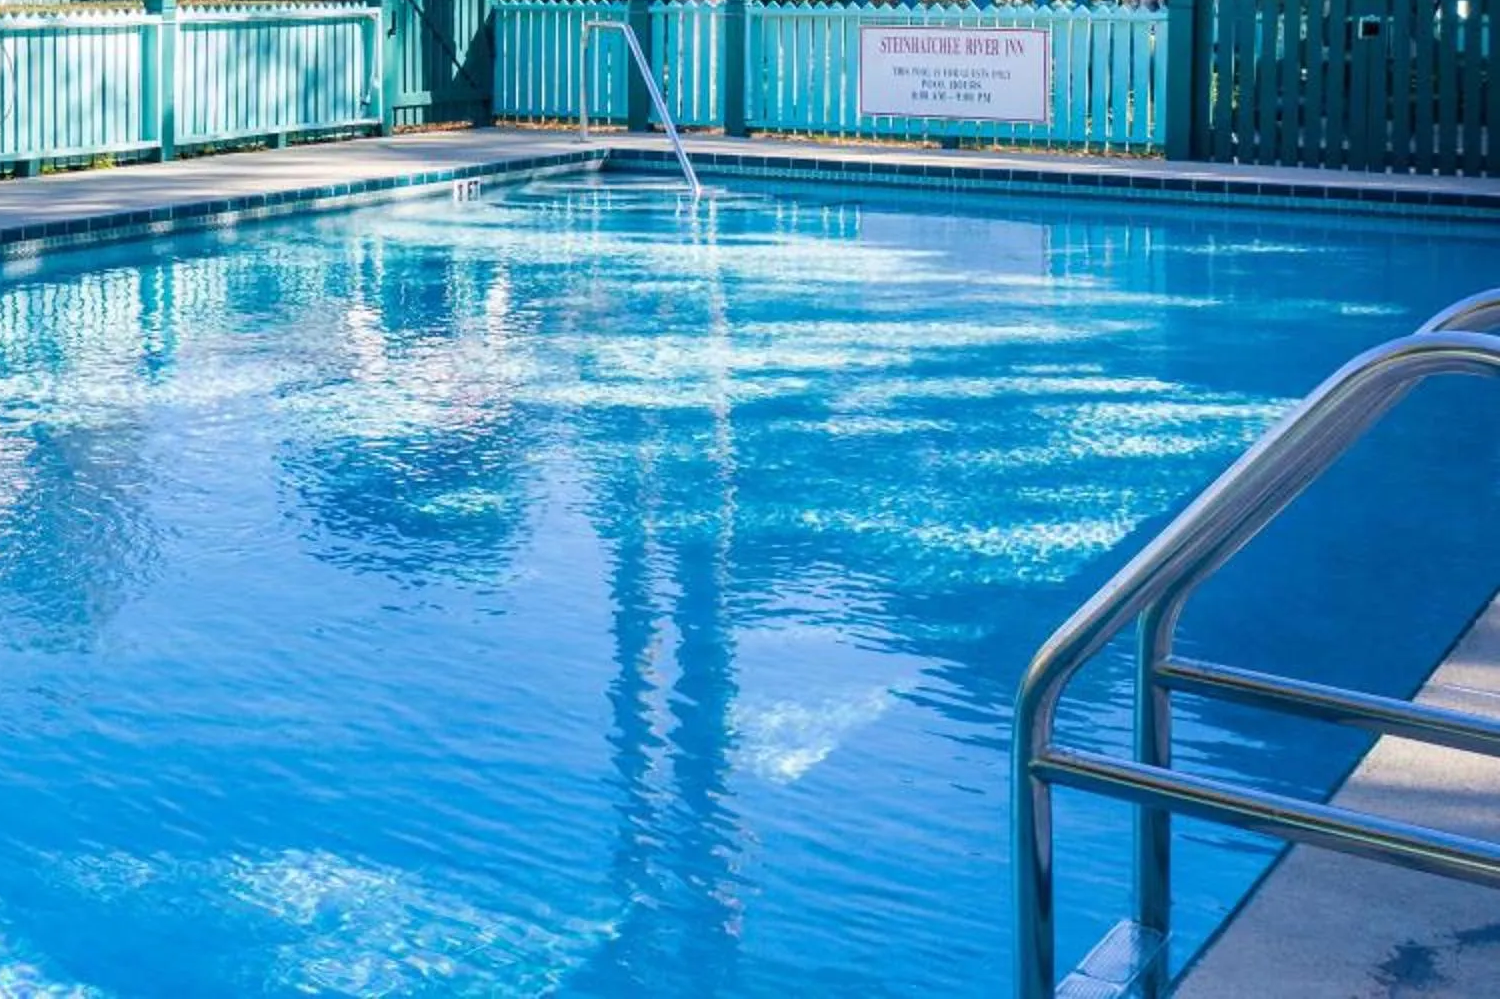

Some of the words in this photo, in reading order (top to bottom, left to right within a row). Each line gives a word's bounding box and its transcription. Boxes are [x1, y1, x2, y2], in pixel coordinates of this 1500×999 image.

[879, 36, 961, 55] STEINHATCHEE
[965, 37, 999, 56] RIVER
[1005, 38, 1025, 57] INN
